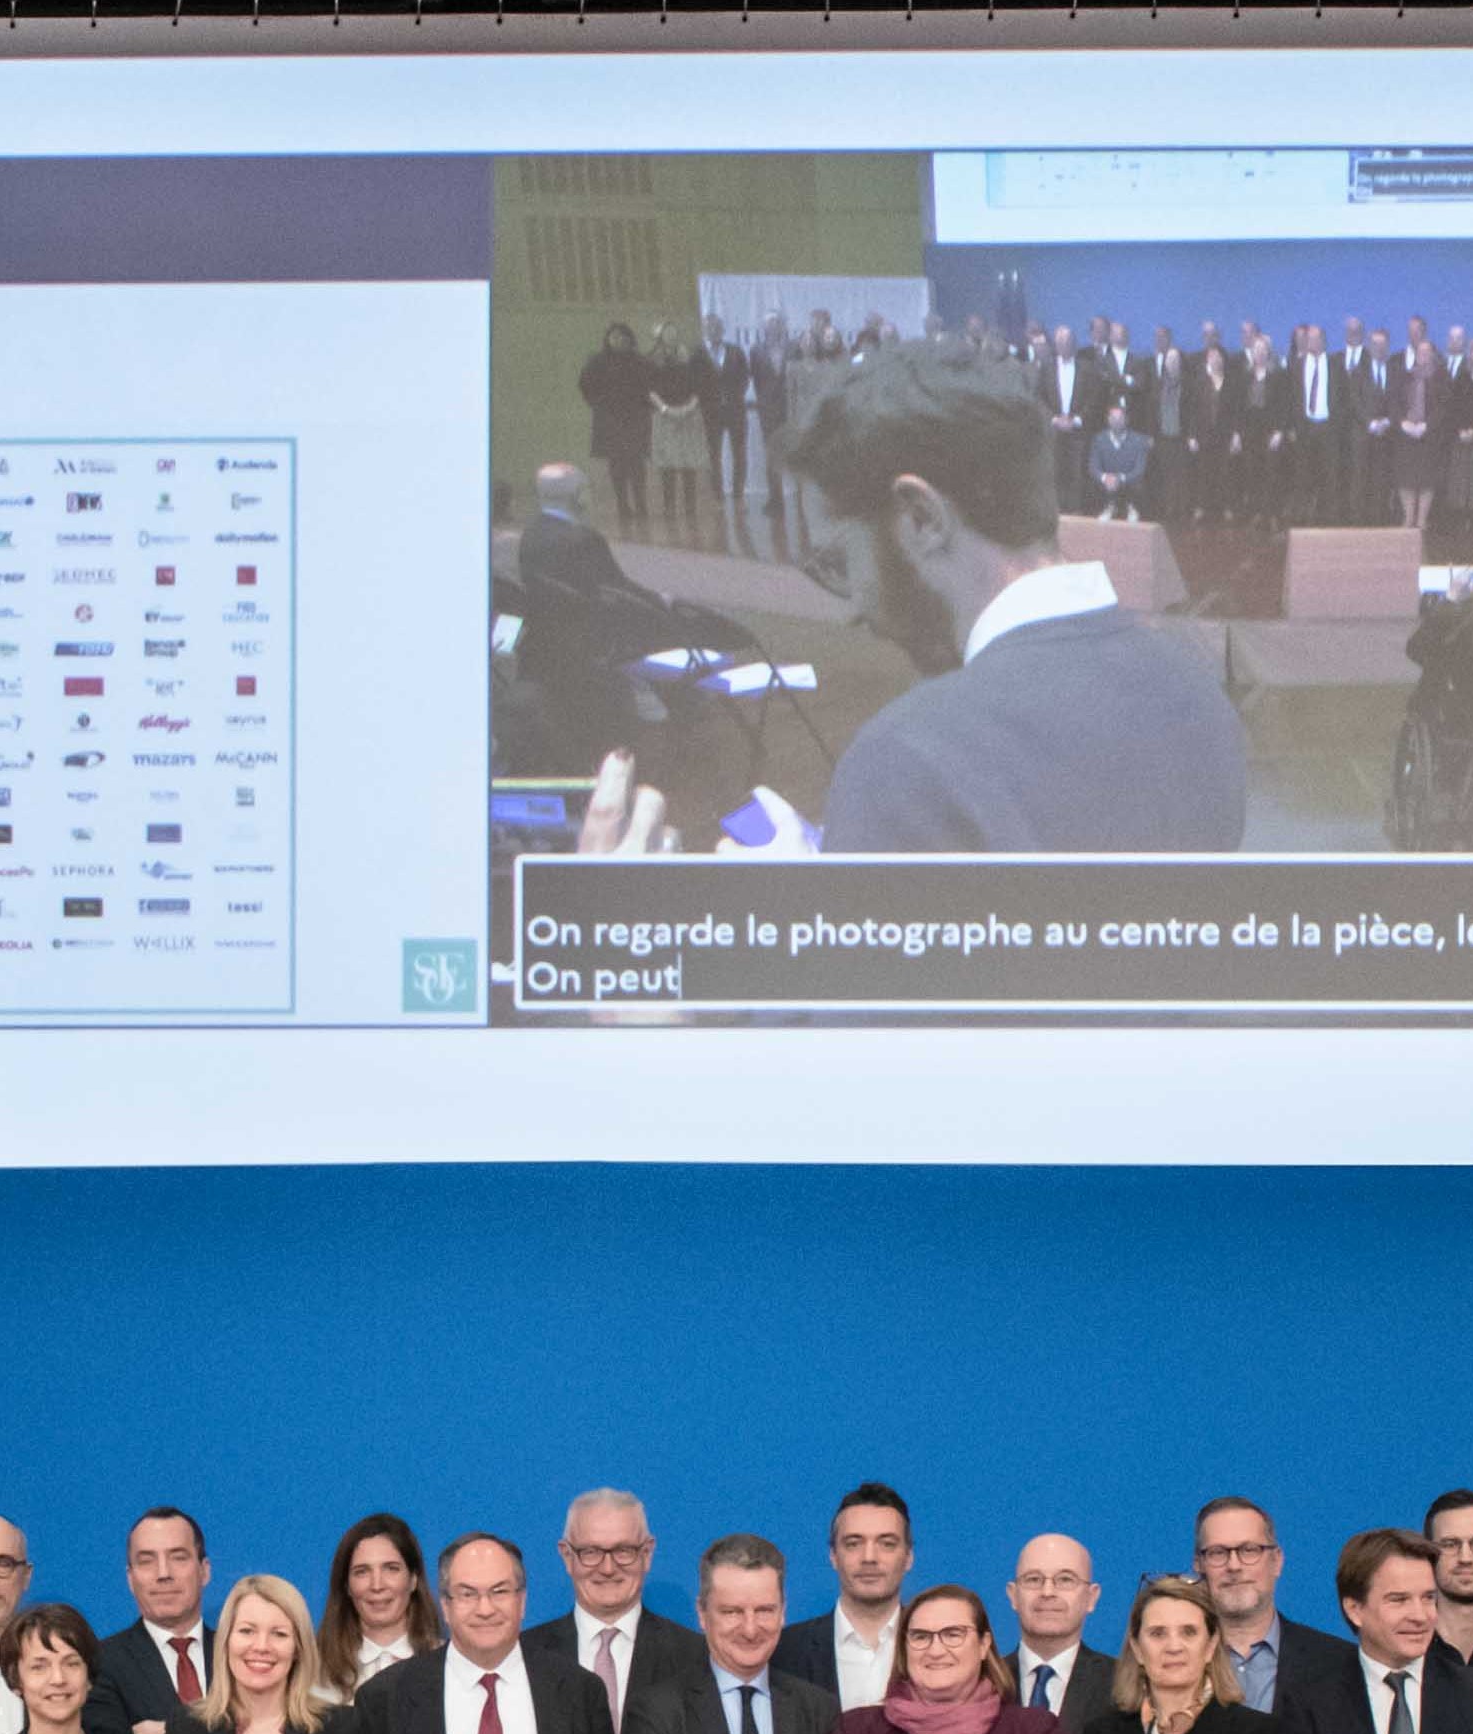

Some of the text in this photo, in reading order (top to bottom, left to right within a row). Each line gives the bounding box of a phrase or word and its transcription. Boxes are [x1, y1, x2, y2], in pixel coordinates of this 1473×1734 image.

[138, 714, 191, 732] Kellogg's
[133, 754, 196, 766] mazars
[215, 752, 278, 764] McCANN
[52, 866, 115, 876] SEPHORA
[227, 900, 263, 912] tessi
[527, 915, 581, 946] On
[594, 913, 736, 955] regarde
[748, 913, 778, 946] le
[790, 913, 1033, 956] photographe
[1044, 921, 1088, 947] au
[1099, 917, 1221, 948] centre
[1231, 913, 1280, 947] de
[1292, 913, 1321, 947] la
[1334, 913, 1445, 957] pièce,
[527, 962, 680, 1000] On peut
